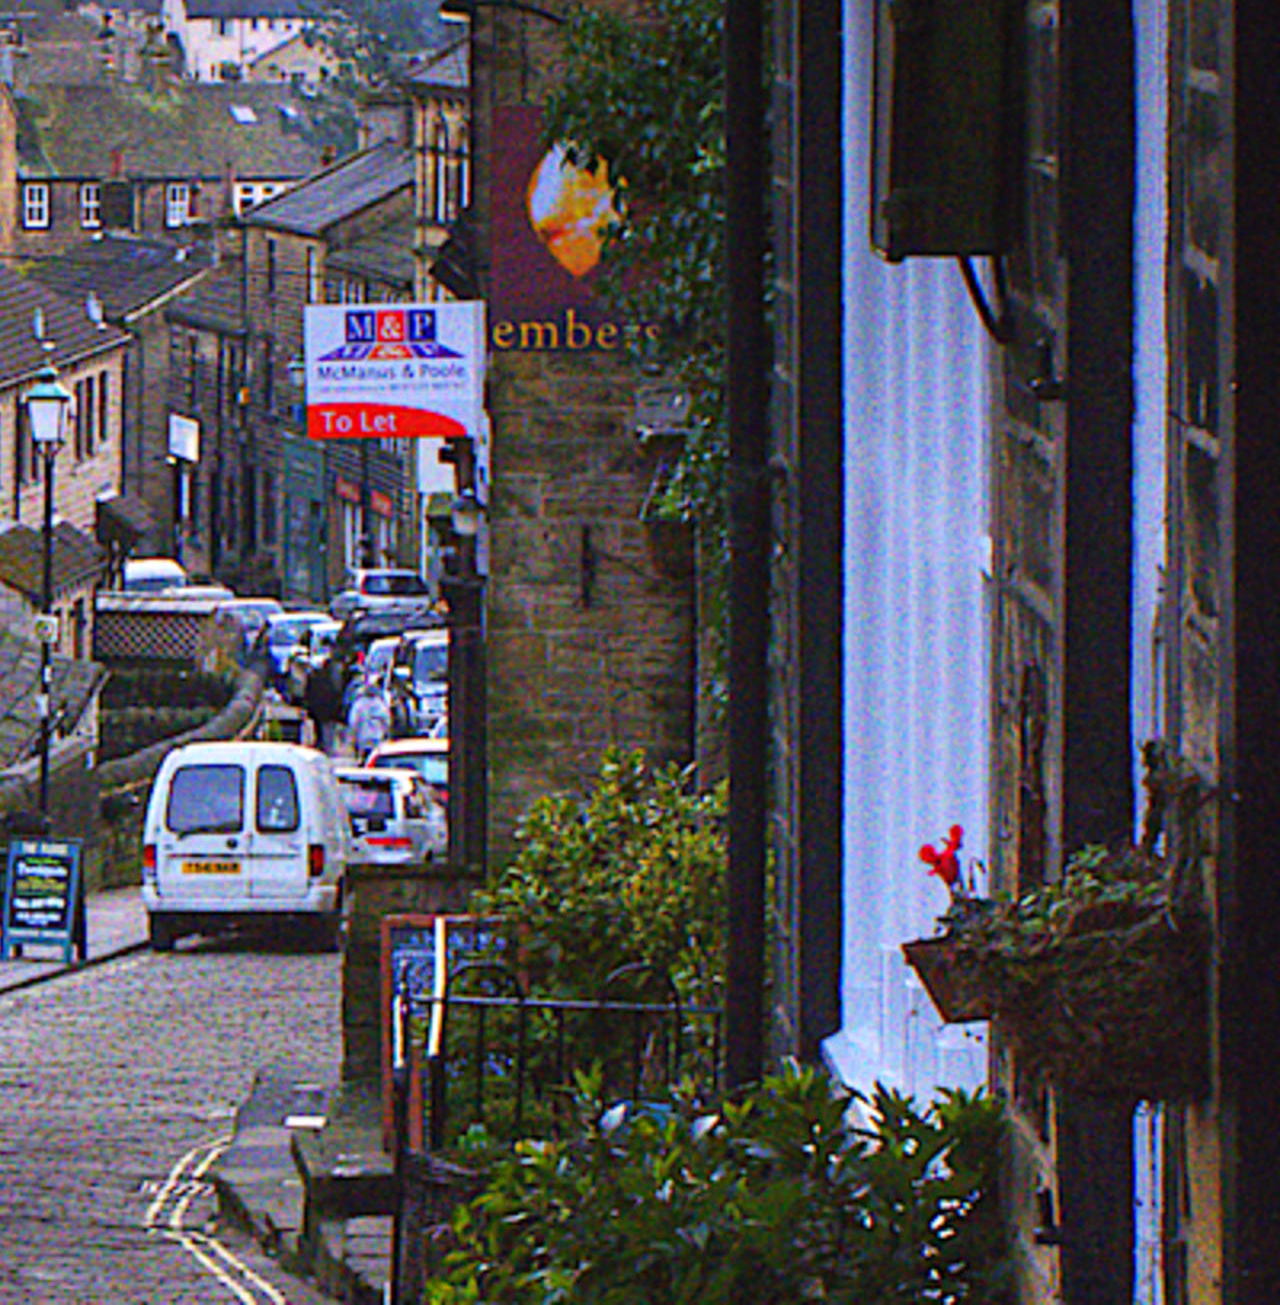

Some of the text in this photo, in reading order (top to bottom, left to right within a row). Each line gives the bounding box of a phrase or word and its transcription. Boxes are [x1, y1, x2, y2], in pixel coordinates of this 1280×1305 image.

[318, 363, 465, 381] McManus & Poole
[320, 411, 397, 433] To Let
